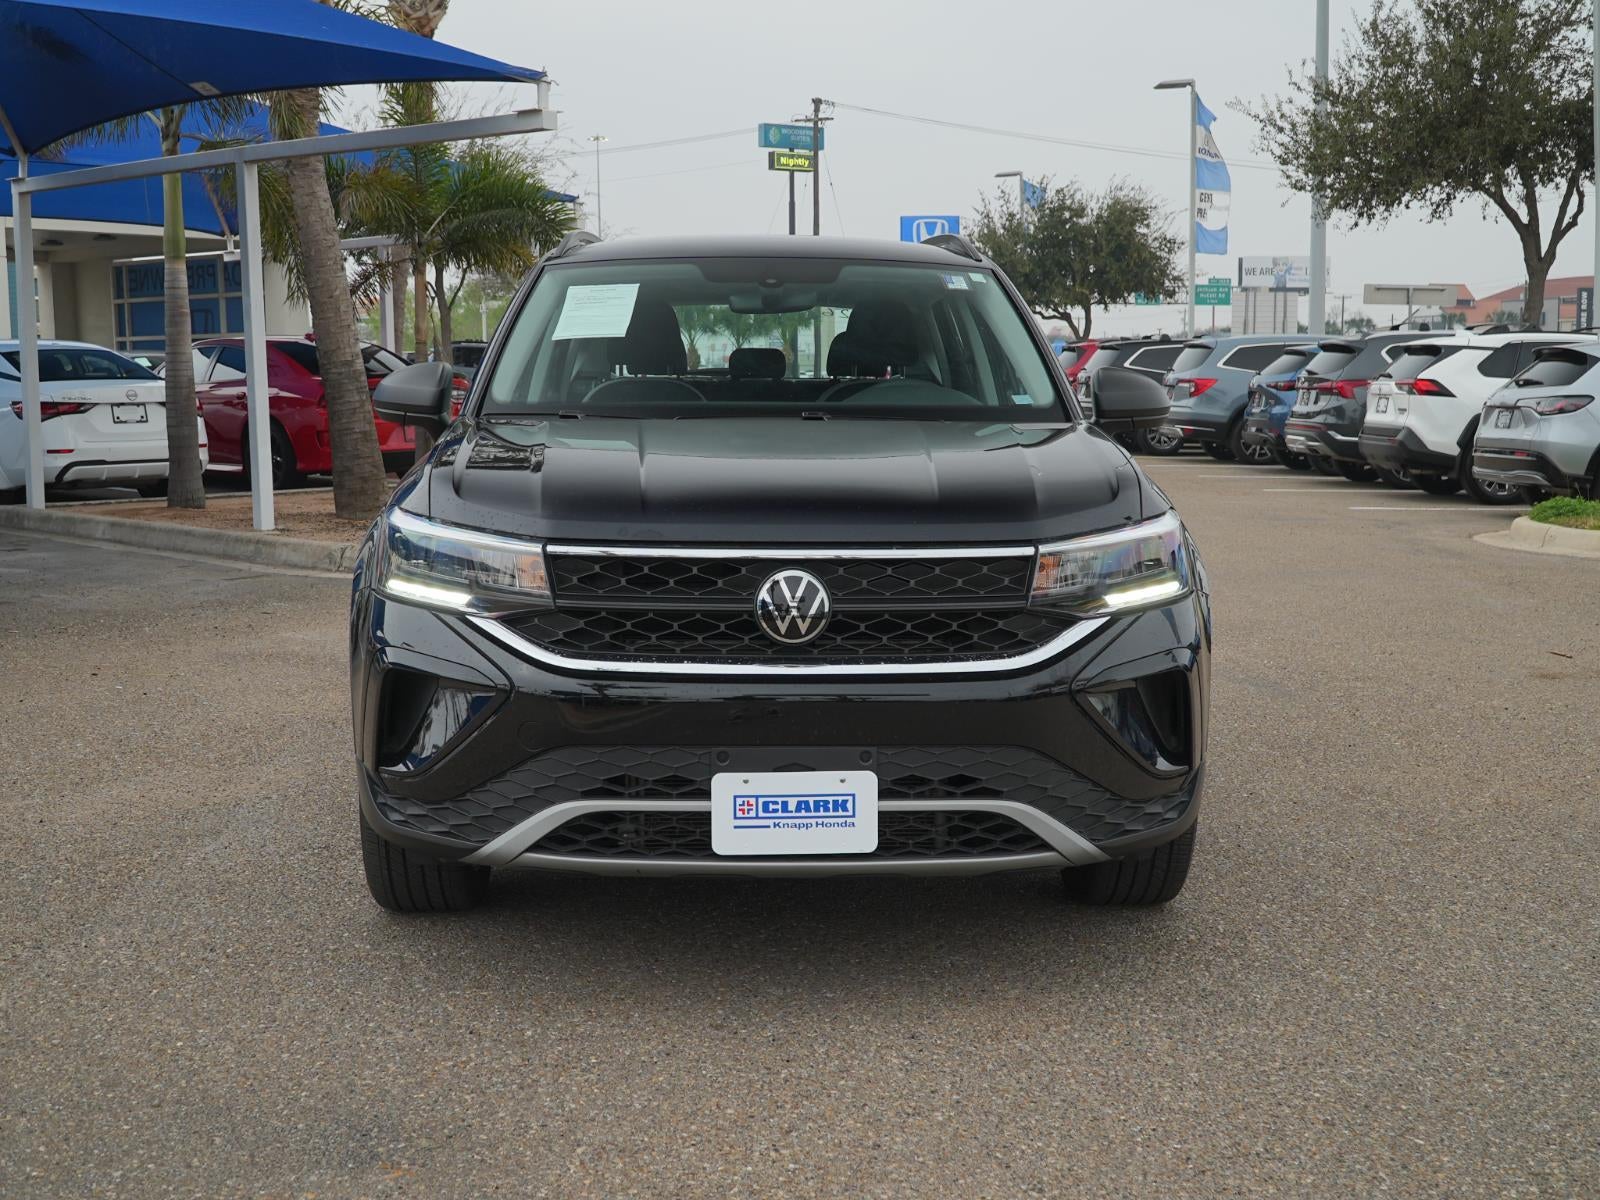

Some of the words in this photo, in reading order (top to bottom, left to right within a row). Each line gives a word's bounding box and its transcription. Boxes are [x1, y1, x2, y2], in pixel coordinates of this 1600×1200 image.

[780, 157, 809, 167] Nightly
[1244, 266, 1258, 276] WE
[1259, 266, 1275, 276] ARE
[762, 799, 850, 814] CLARK
[773, 821, 813, 830] Knapp
[815, 820, 856, 829] Honda
